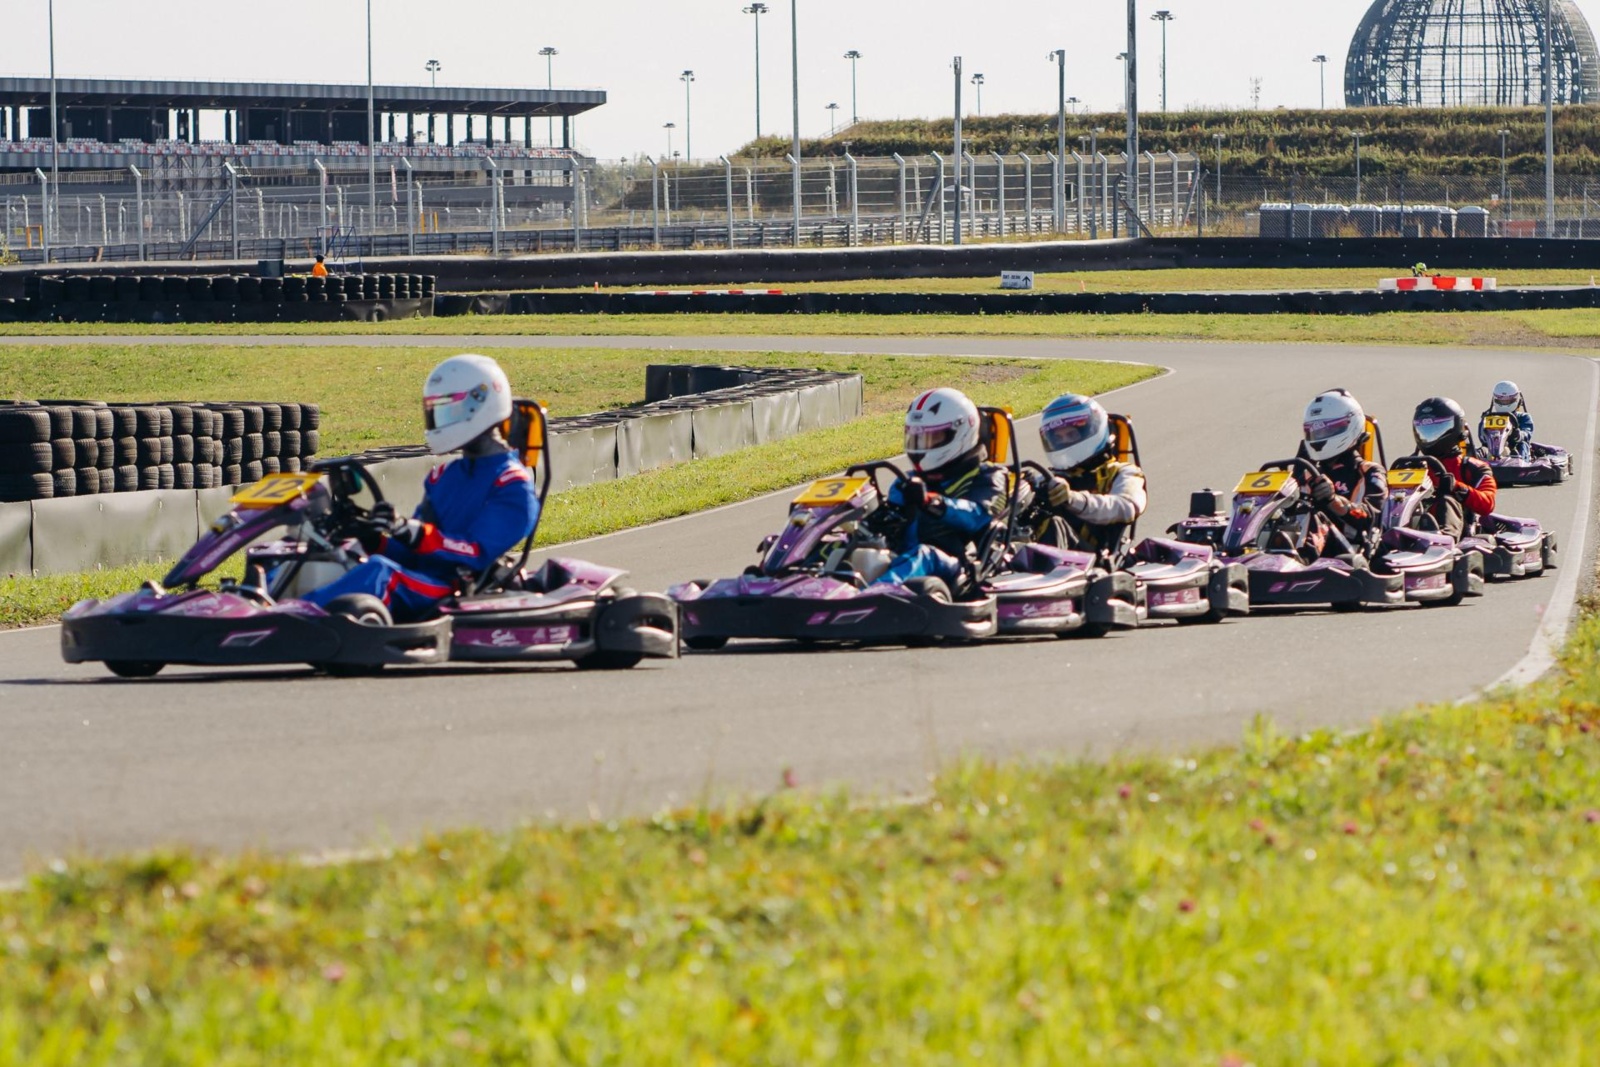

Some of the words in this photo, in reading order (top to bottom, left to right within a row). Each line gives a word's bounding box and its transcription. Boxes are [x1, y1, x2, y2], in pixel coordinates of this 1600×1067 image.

[1487, 418, 1506, 426] 10
[1251, 473, 1271, 488] 6
[1398, 471, 1415, 482] 7
[251, 478, 304, 498] 12
[815, 482, 845, 498] 3
